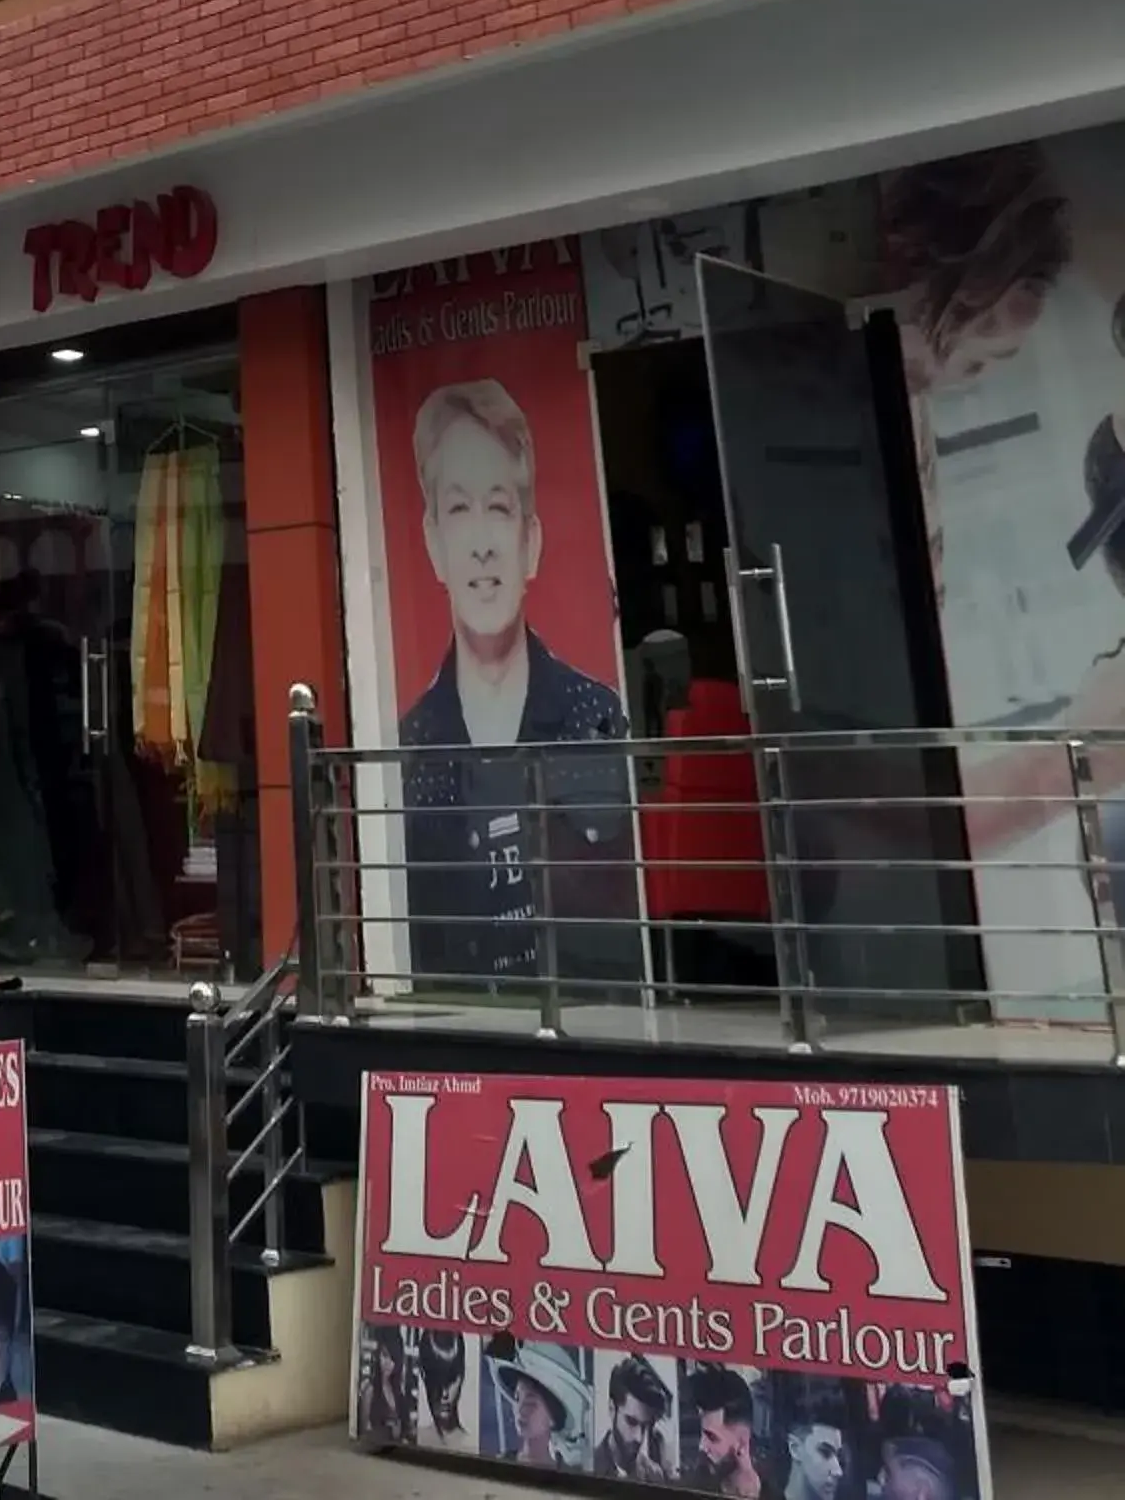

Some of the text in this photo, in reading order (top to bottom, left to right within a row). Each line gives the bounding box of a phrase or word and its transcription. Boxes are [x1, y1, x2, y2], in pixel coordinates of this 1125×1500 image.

[22, 185, 218, 313] TREND
[440, 298, 499, 341] Gents
[503, 288, 577, 332] Parlour
[399, 1075, 439, 1092] Imtiaz
[442, 1076, 482, 1094] Ahmd
[838, 1086, 938, 1108] 9719020374
[381, 1095, 948, 1302] LAIVA
[371, 1265, 956, 1376] Ladies & Gents Parlour
